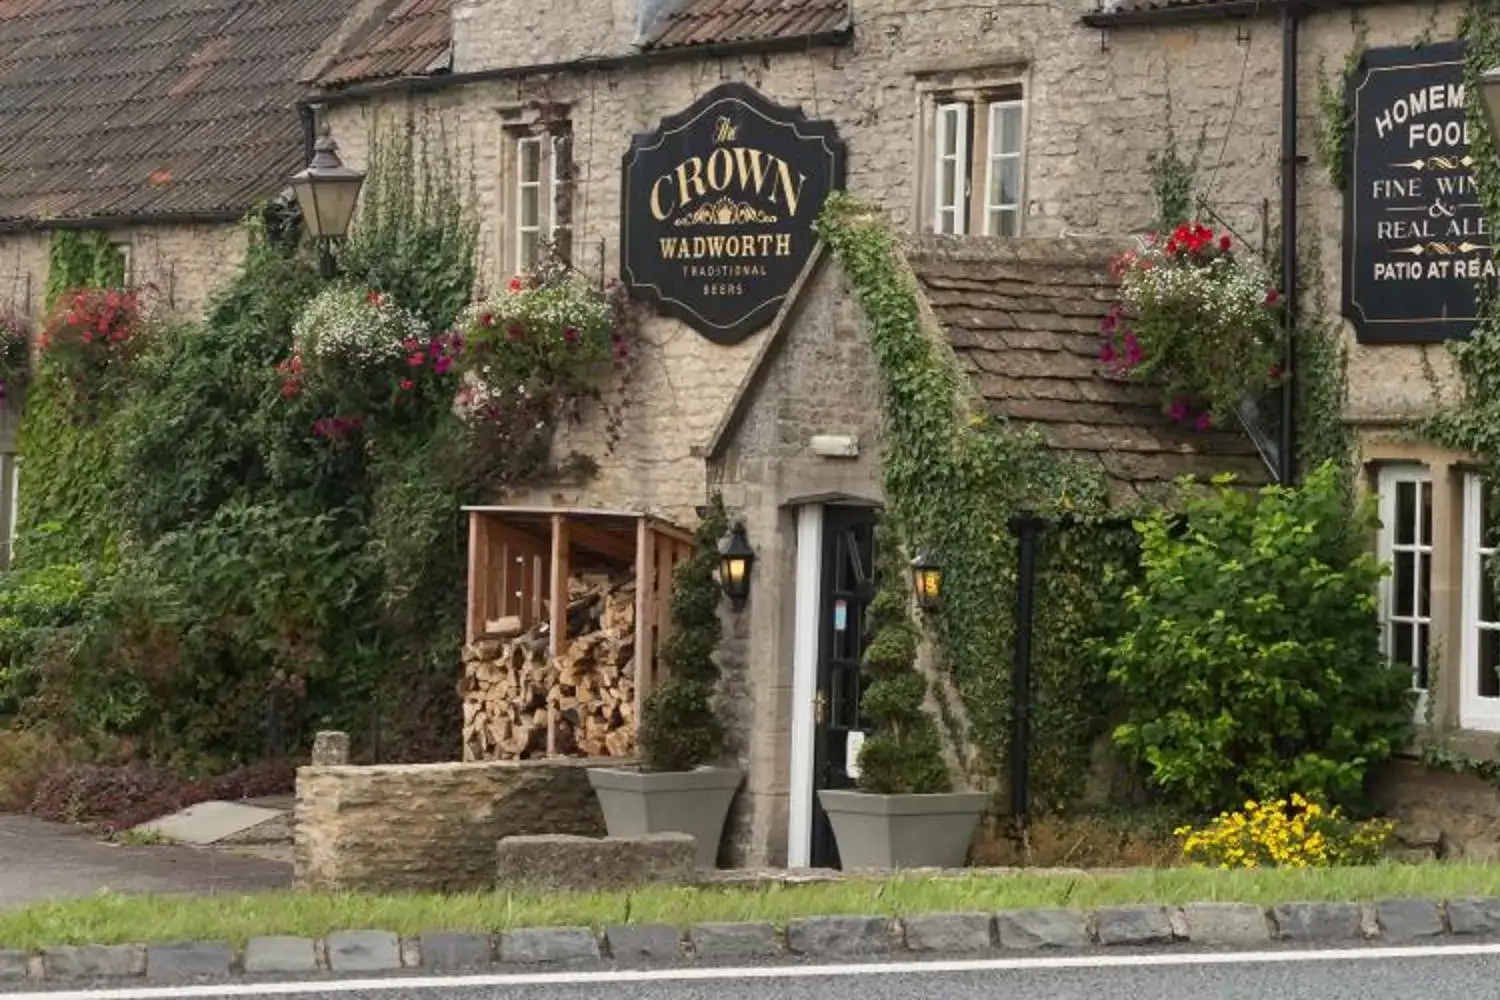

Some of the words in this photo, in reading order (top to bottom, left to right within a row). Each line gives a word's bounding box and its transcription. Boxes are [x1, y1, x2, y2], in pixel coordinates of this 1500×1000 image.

[650, 147, 806, 222] CROWN
[1372, 178, 1421, 199] FINE
[1428, 197, 1456, 217] &
[1377, 219, 1436, 239] REAL
[659, 233, 792, 259] WADWORTH
[682, 265, 768, 277] TRADITIONAL
[1374, 261, 1423, 280] PATIO
[1427, 260, 1449, 278] AT
[703, 283, 743, 295] BEERS
